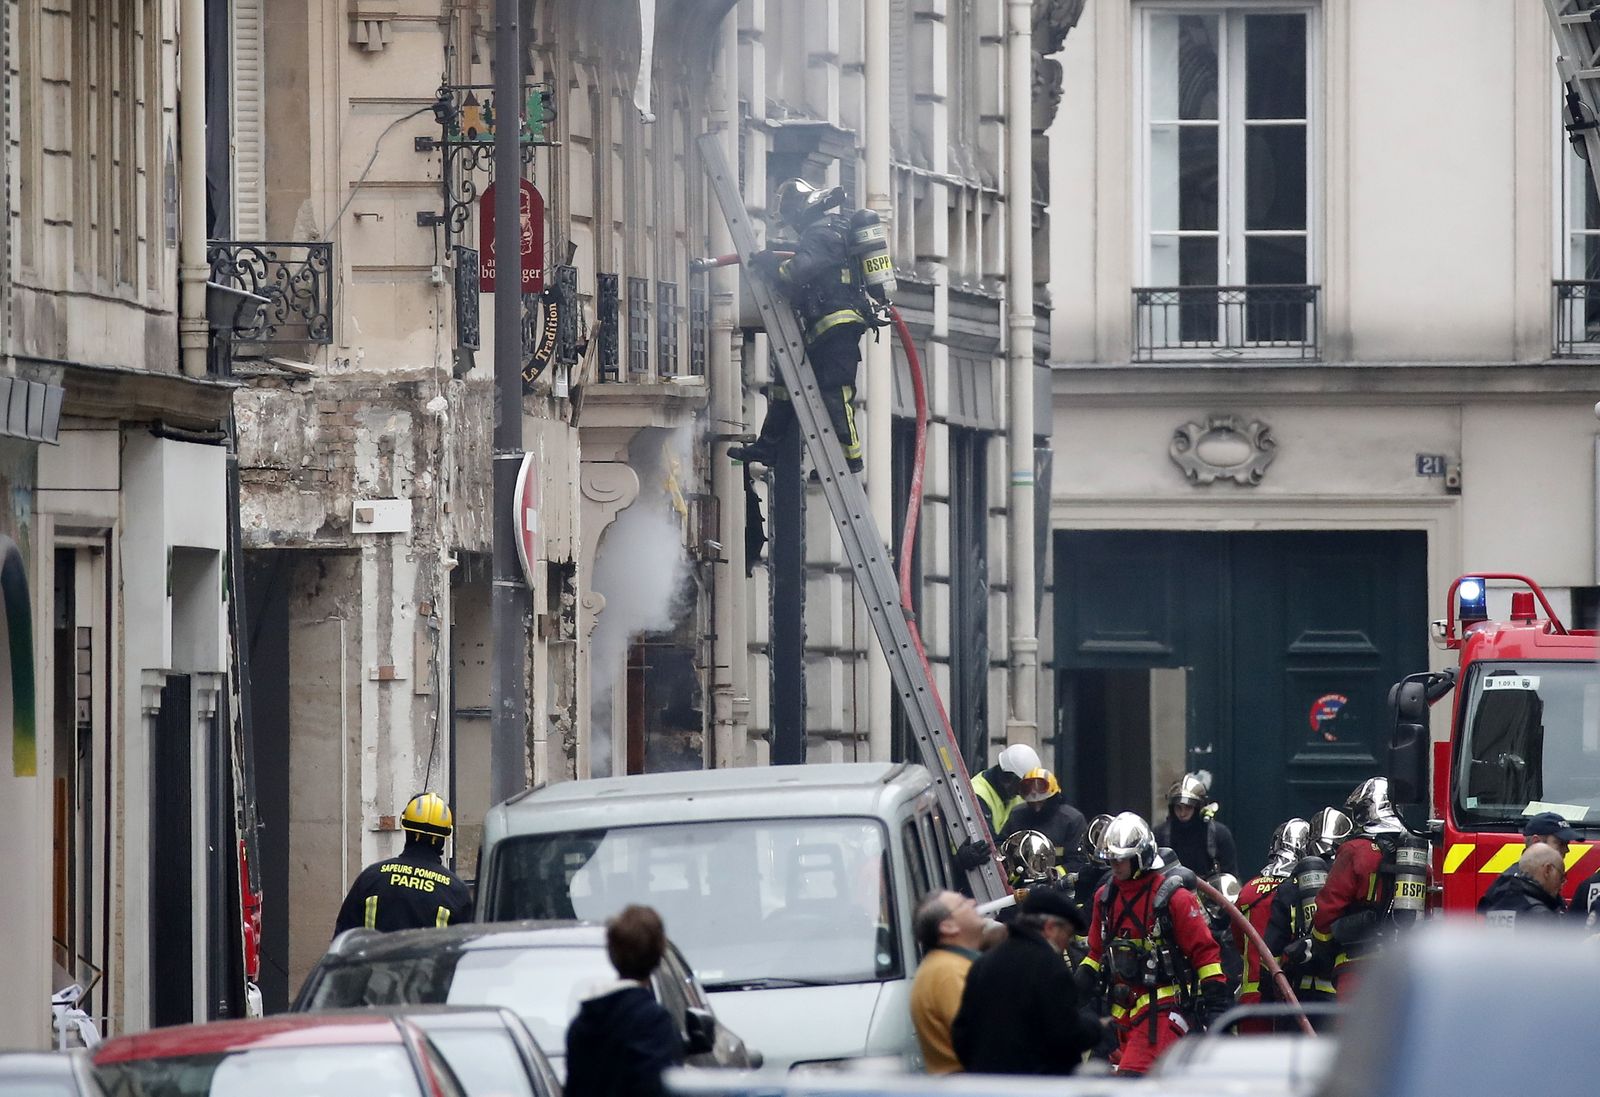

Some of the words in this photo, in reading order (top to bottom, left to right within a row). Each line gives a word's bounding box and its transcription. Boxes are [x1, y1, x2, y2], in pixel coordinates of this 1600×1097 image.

[865, 256, 890, 273] BSPP
[481, 265, 541, 283] boger
[521, 367, 539, 382] La
[535, 302, 558, 362] Tradition
[1422, 457, 1440, 473] 21
[380, 863, 413, 875] SAPEURS
[413, 867, 451, 885] POMPIERS
[390, 874, 435, 892] PARIS
